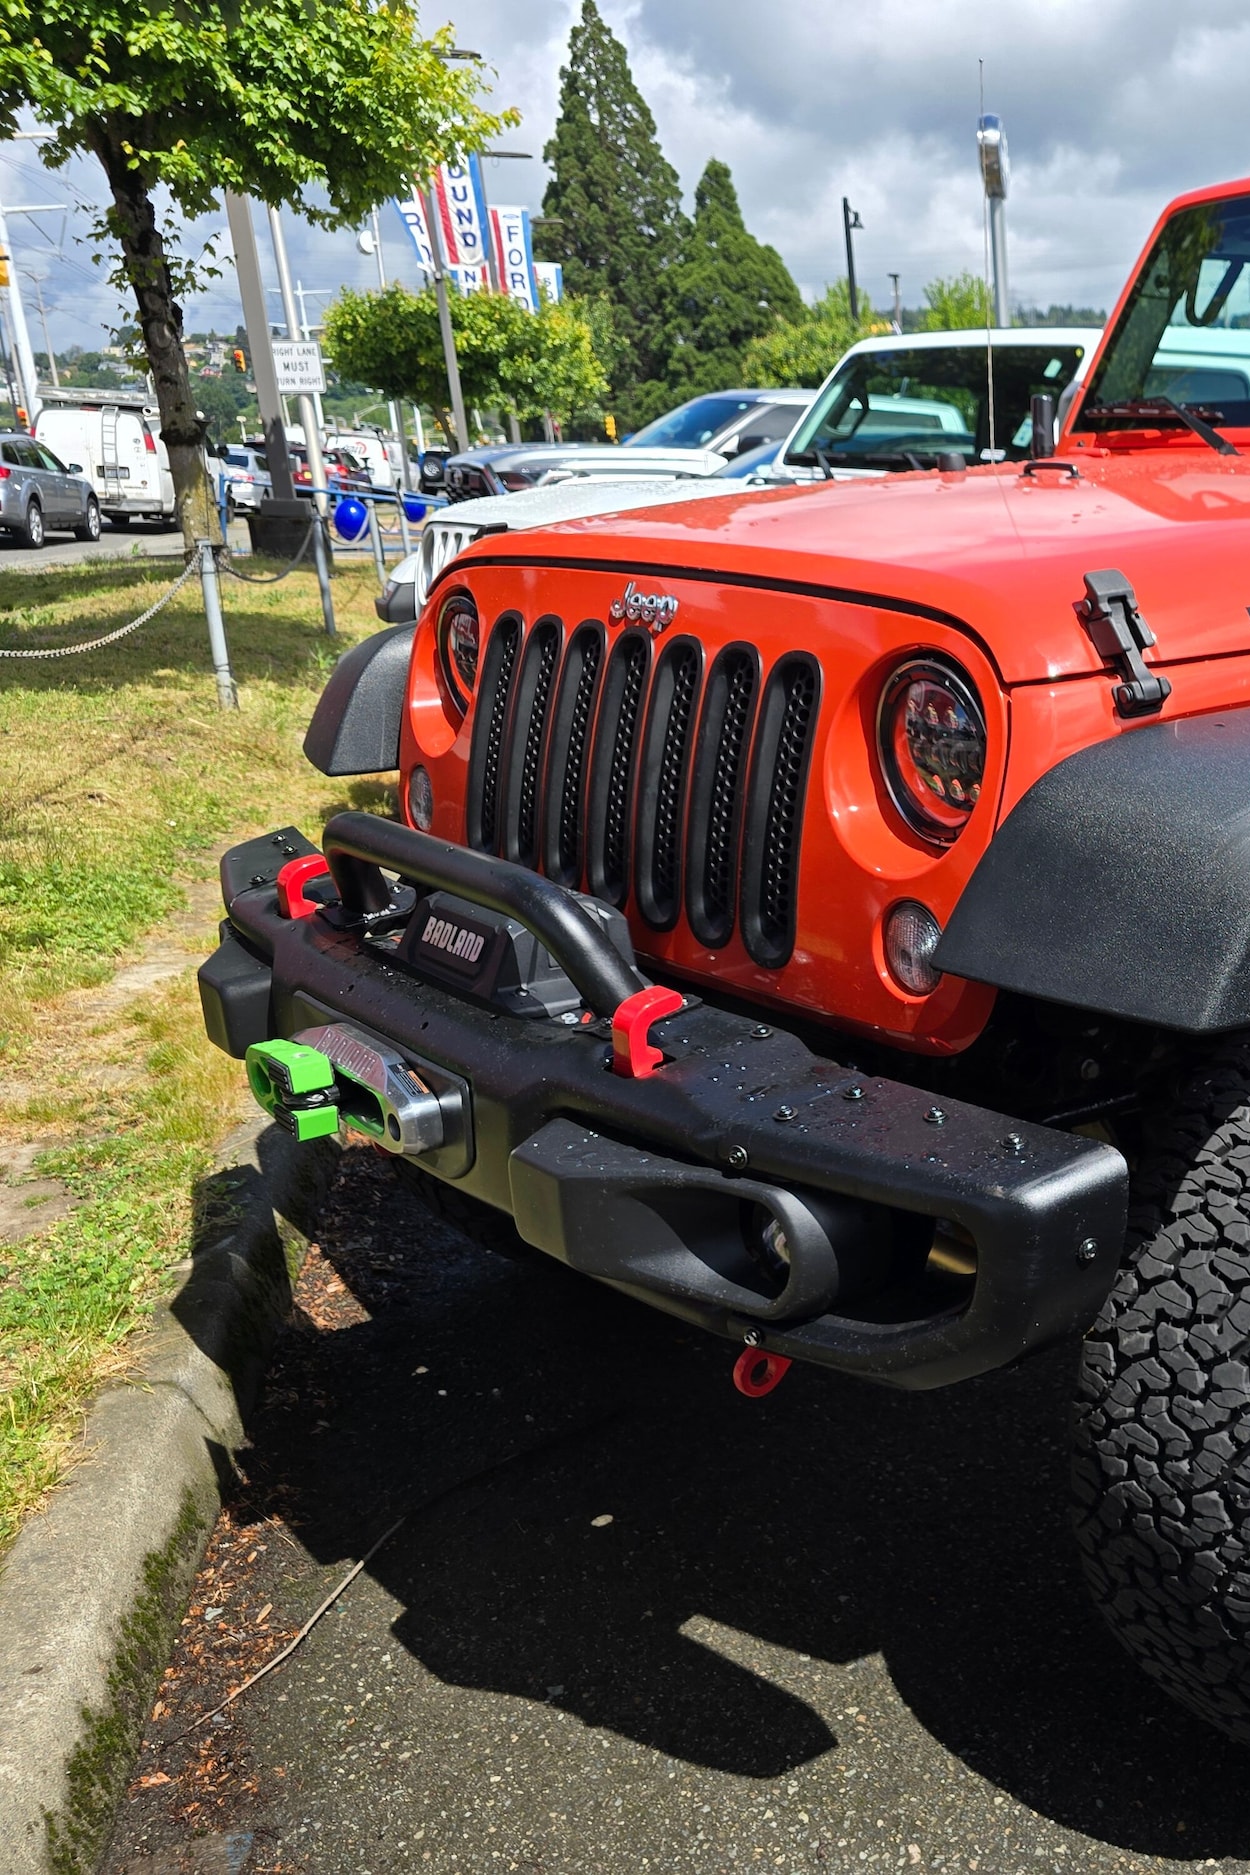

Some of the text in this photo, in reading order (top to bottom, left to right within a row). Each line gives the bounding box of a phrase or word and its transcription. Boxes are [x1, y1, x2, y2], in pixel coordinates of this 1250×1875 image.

[272, 346, 316, 357] RIGHT LANE
[283, 361, 309, 372] MUST
[276, 376, 321, 387] TURN RIGHT
[610, 580, 680, 633] Jeep
[420, 914, 486, 964] BADLAND
